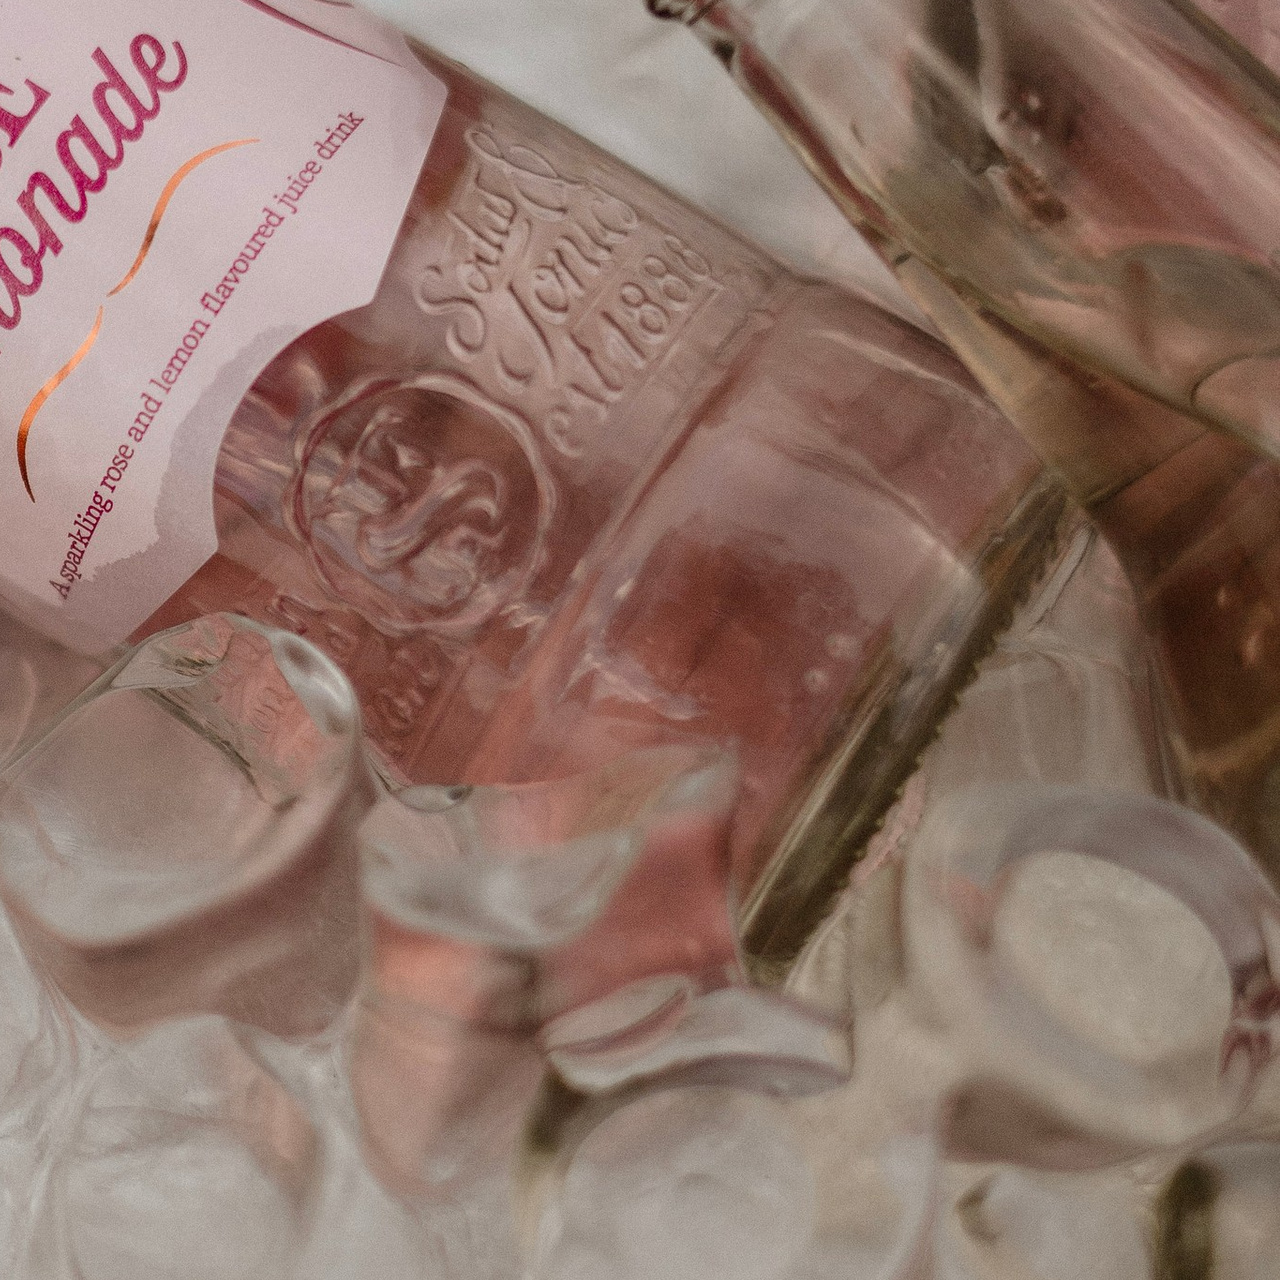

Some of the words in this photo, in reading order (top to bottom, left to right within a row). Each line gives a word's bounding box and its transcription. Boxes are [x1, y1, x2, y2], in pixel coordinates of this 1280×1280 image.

[46, 577, 68, 601] A
[61, 486, 116, 584] sparkling
[99, 441, 135, 496] rose
[127, 387, 165, 445] and
[158, 319, 212, 394] lemon
[199, 207, 286, 319] flavoured
[280, 157, 324, 216] juice
[314, 109, 366, 163] drink
